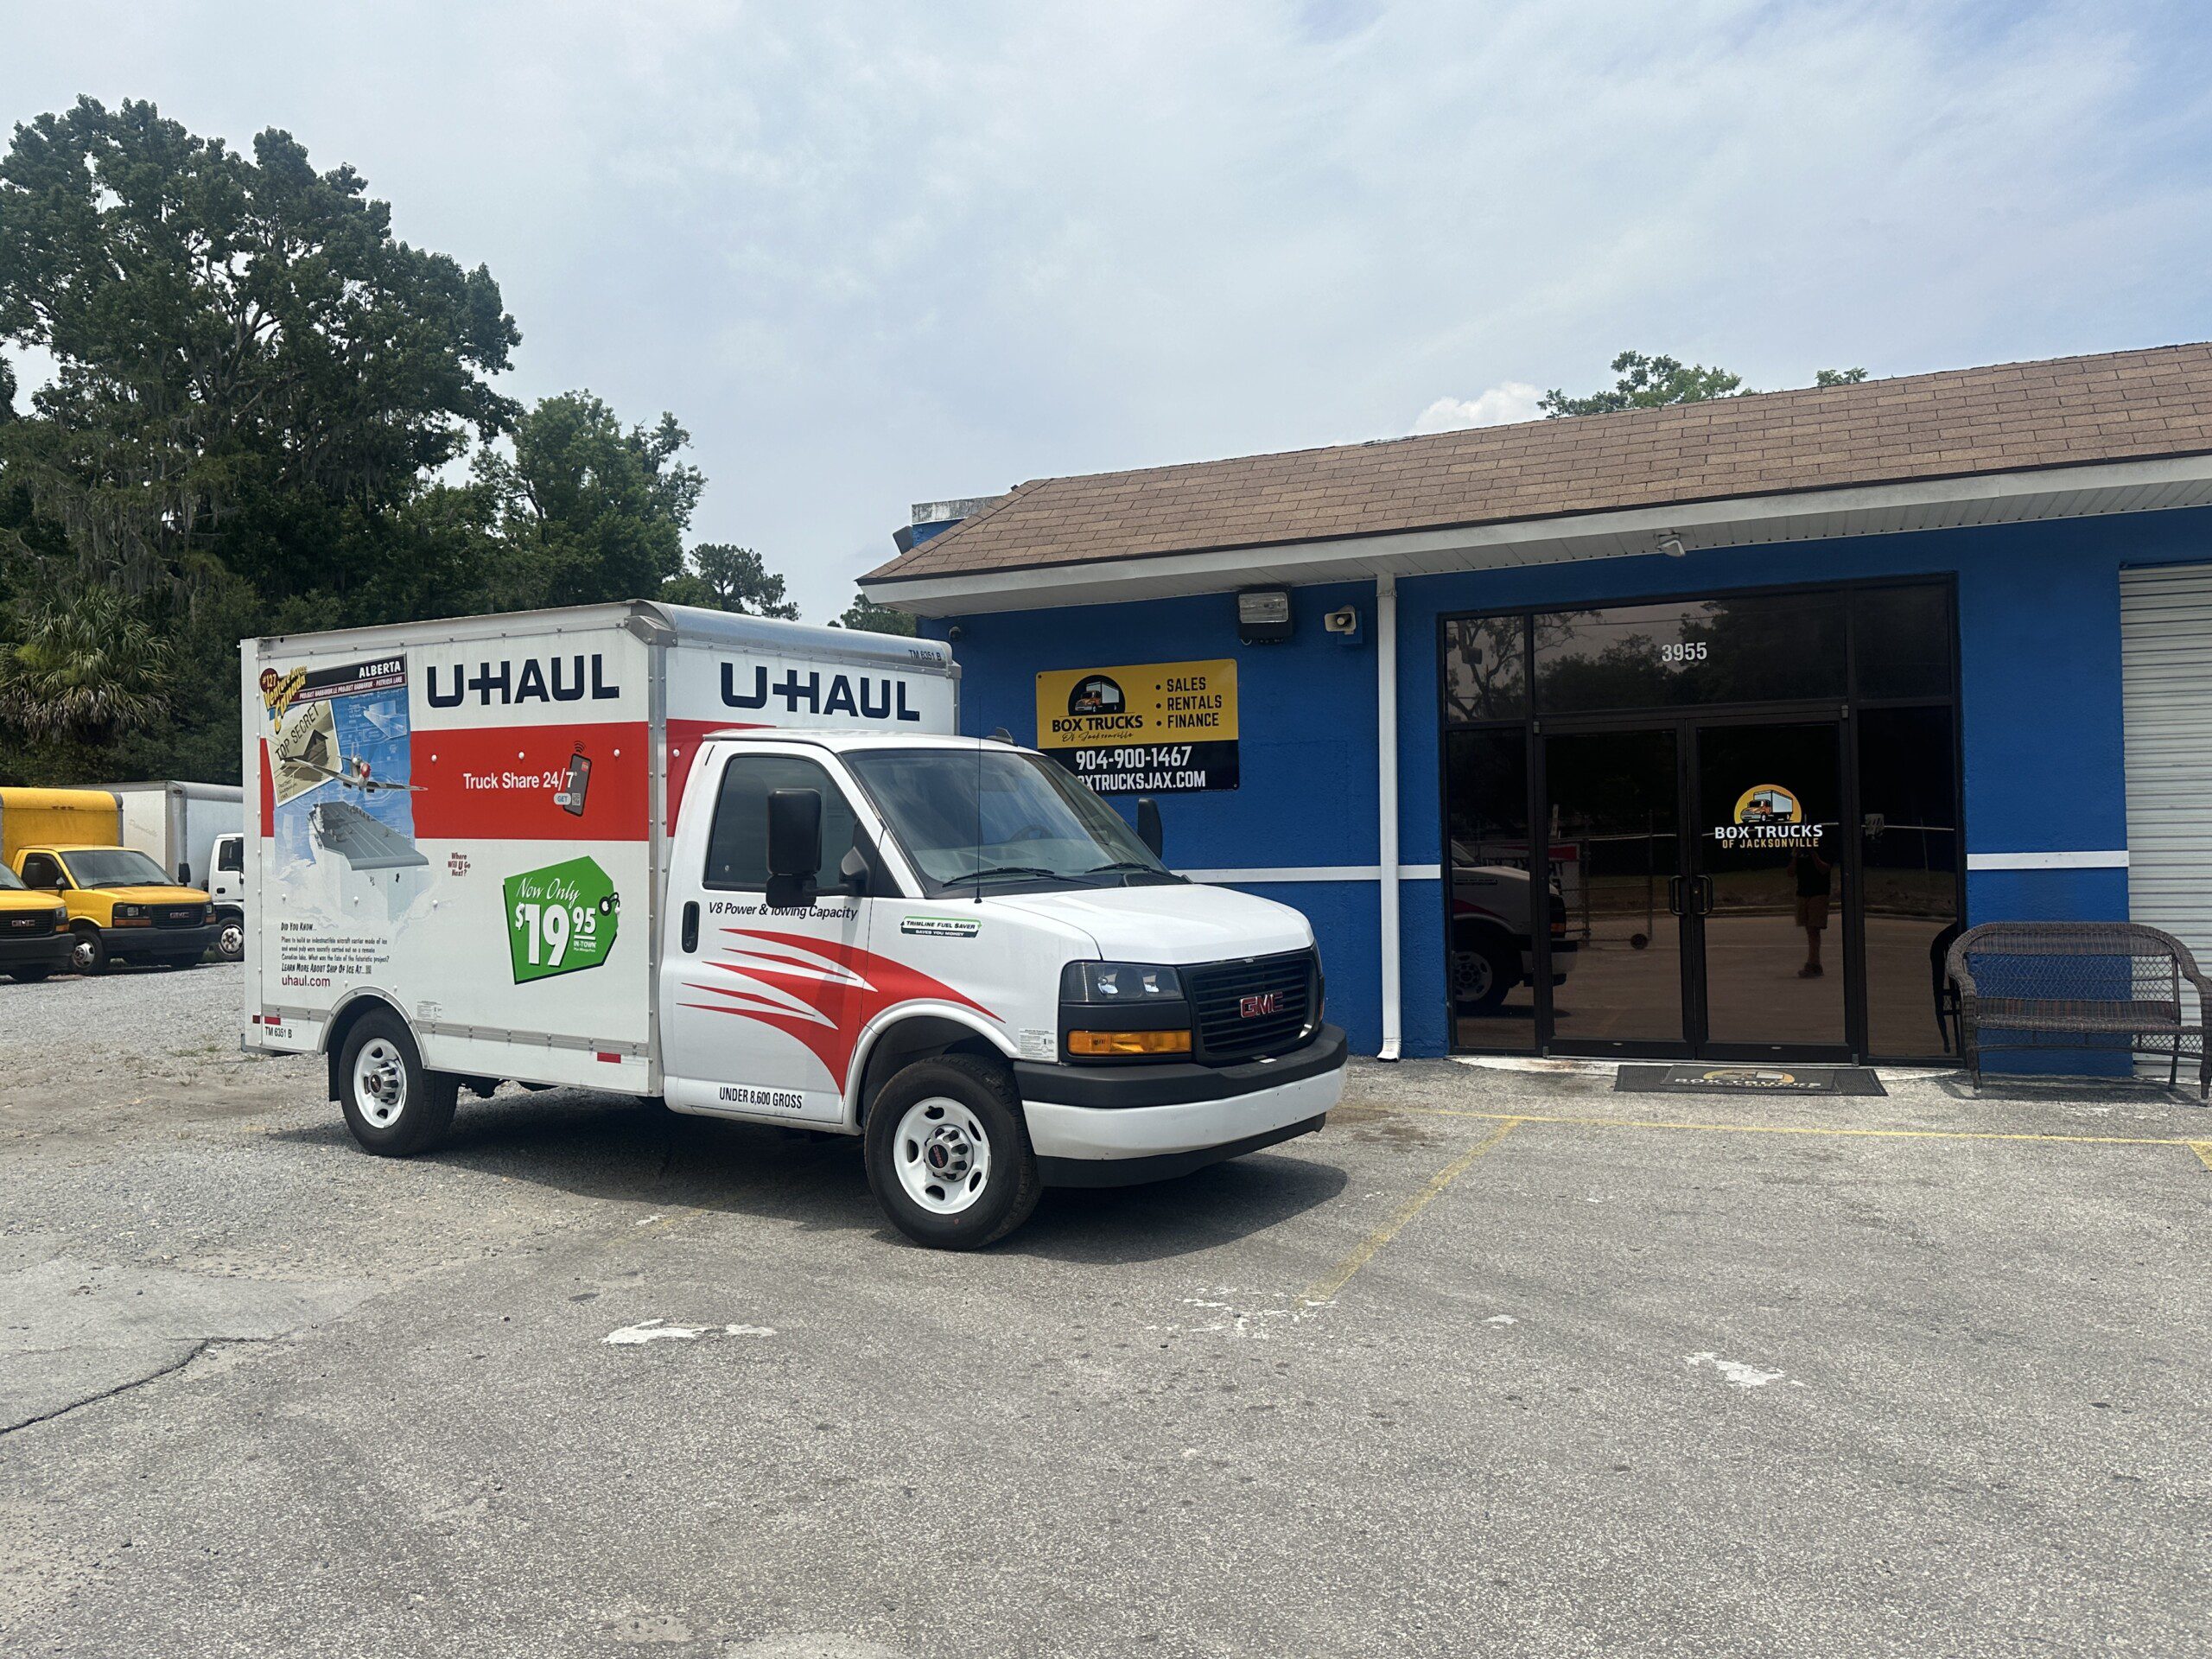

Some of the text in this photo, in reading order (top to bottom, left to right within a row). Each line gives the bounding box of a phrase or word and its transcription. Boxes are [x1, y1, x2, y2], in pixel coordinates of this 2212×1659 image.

[1662, 641, 1707, 663] 3955
[359, 660, 402, 679] ALBERTA
[262, 673, 276, 688] #127
[426, 653, 620, 709] U-HAUL
[1166, 677, 1206, 693] SALES
[264, 675, 290, 712] Venture
[721, 662, 920, 722] U-HAUL
[1166, 695, 1223, 711] RENTALS
[1052, 715, 1143, 733] BOX TRUCKS
[1167, 713, 1219, 728] FINANCE
[275, 739, 290, 762] TOP
[291, 702, 320, 743] SECRET
[1078, 731, 1134, 741] Jacksonville
[1076, 746, 1192, 771] 904-900-1467
[463, 772, 499, 789] Truck
[502, 772, 540, 789] Share
[1714, 824, 1823, 839] BOX TRUCKS
[1722, 837, 1819, 849] OF JACKSONVILLE
[458, 861, 463, 870] U
[516, 877, 581, 910] Now Only
[709, 901, 722, 914] V8
[724, 902, 757, 916] Power
[759, 903, 768, 916] &
[809, 905, 858, 921] Capacity
[296, 963, 309, 972] MORE
[310, 963, 326, 973] ABOUT
[282, 975, 331, 988] uhaul.com
[1240, 991, 1283, 1018] GMC
[264, 1026, 292, 1038] TM 6351 B
[720, 1087, 803, 1109] UNDER 8,600 GROSS
